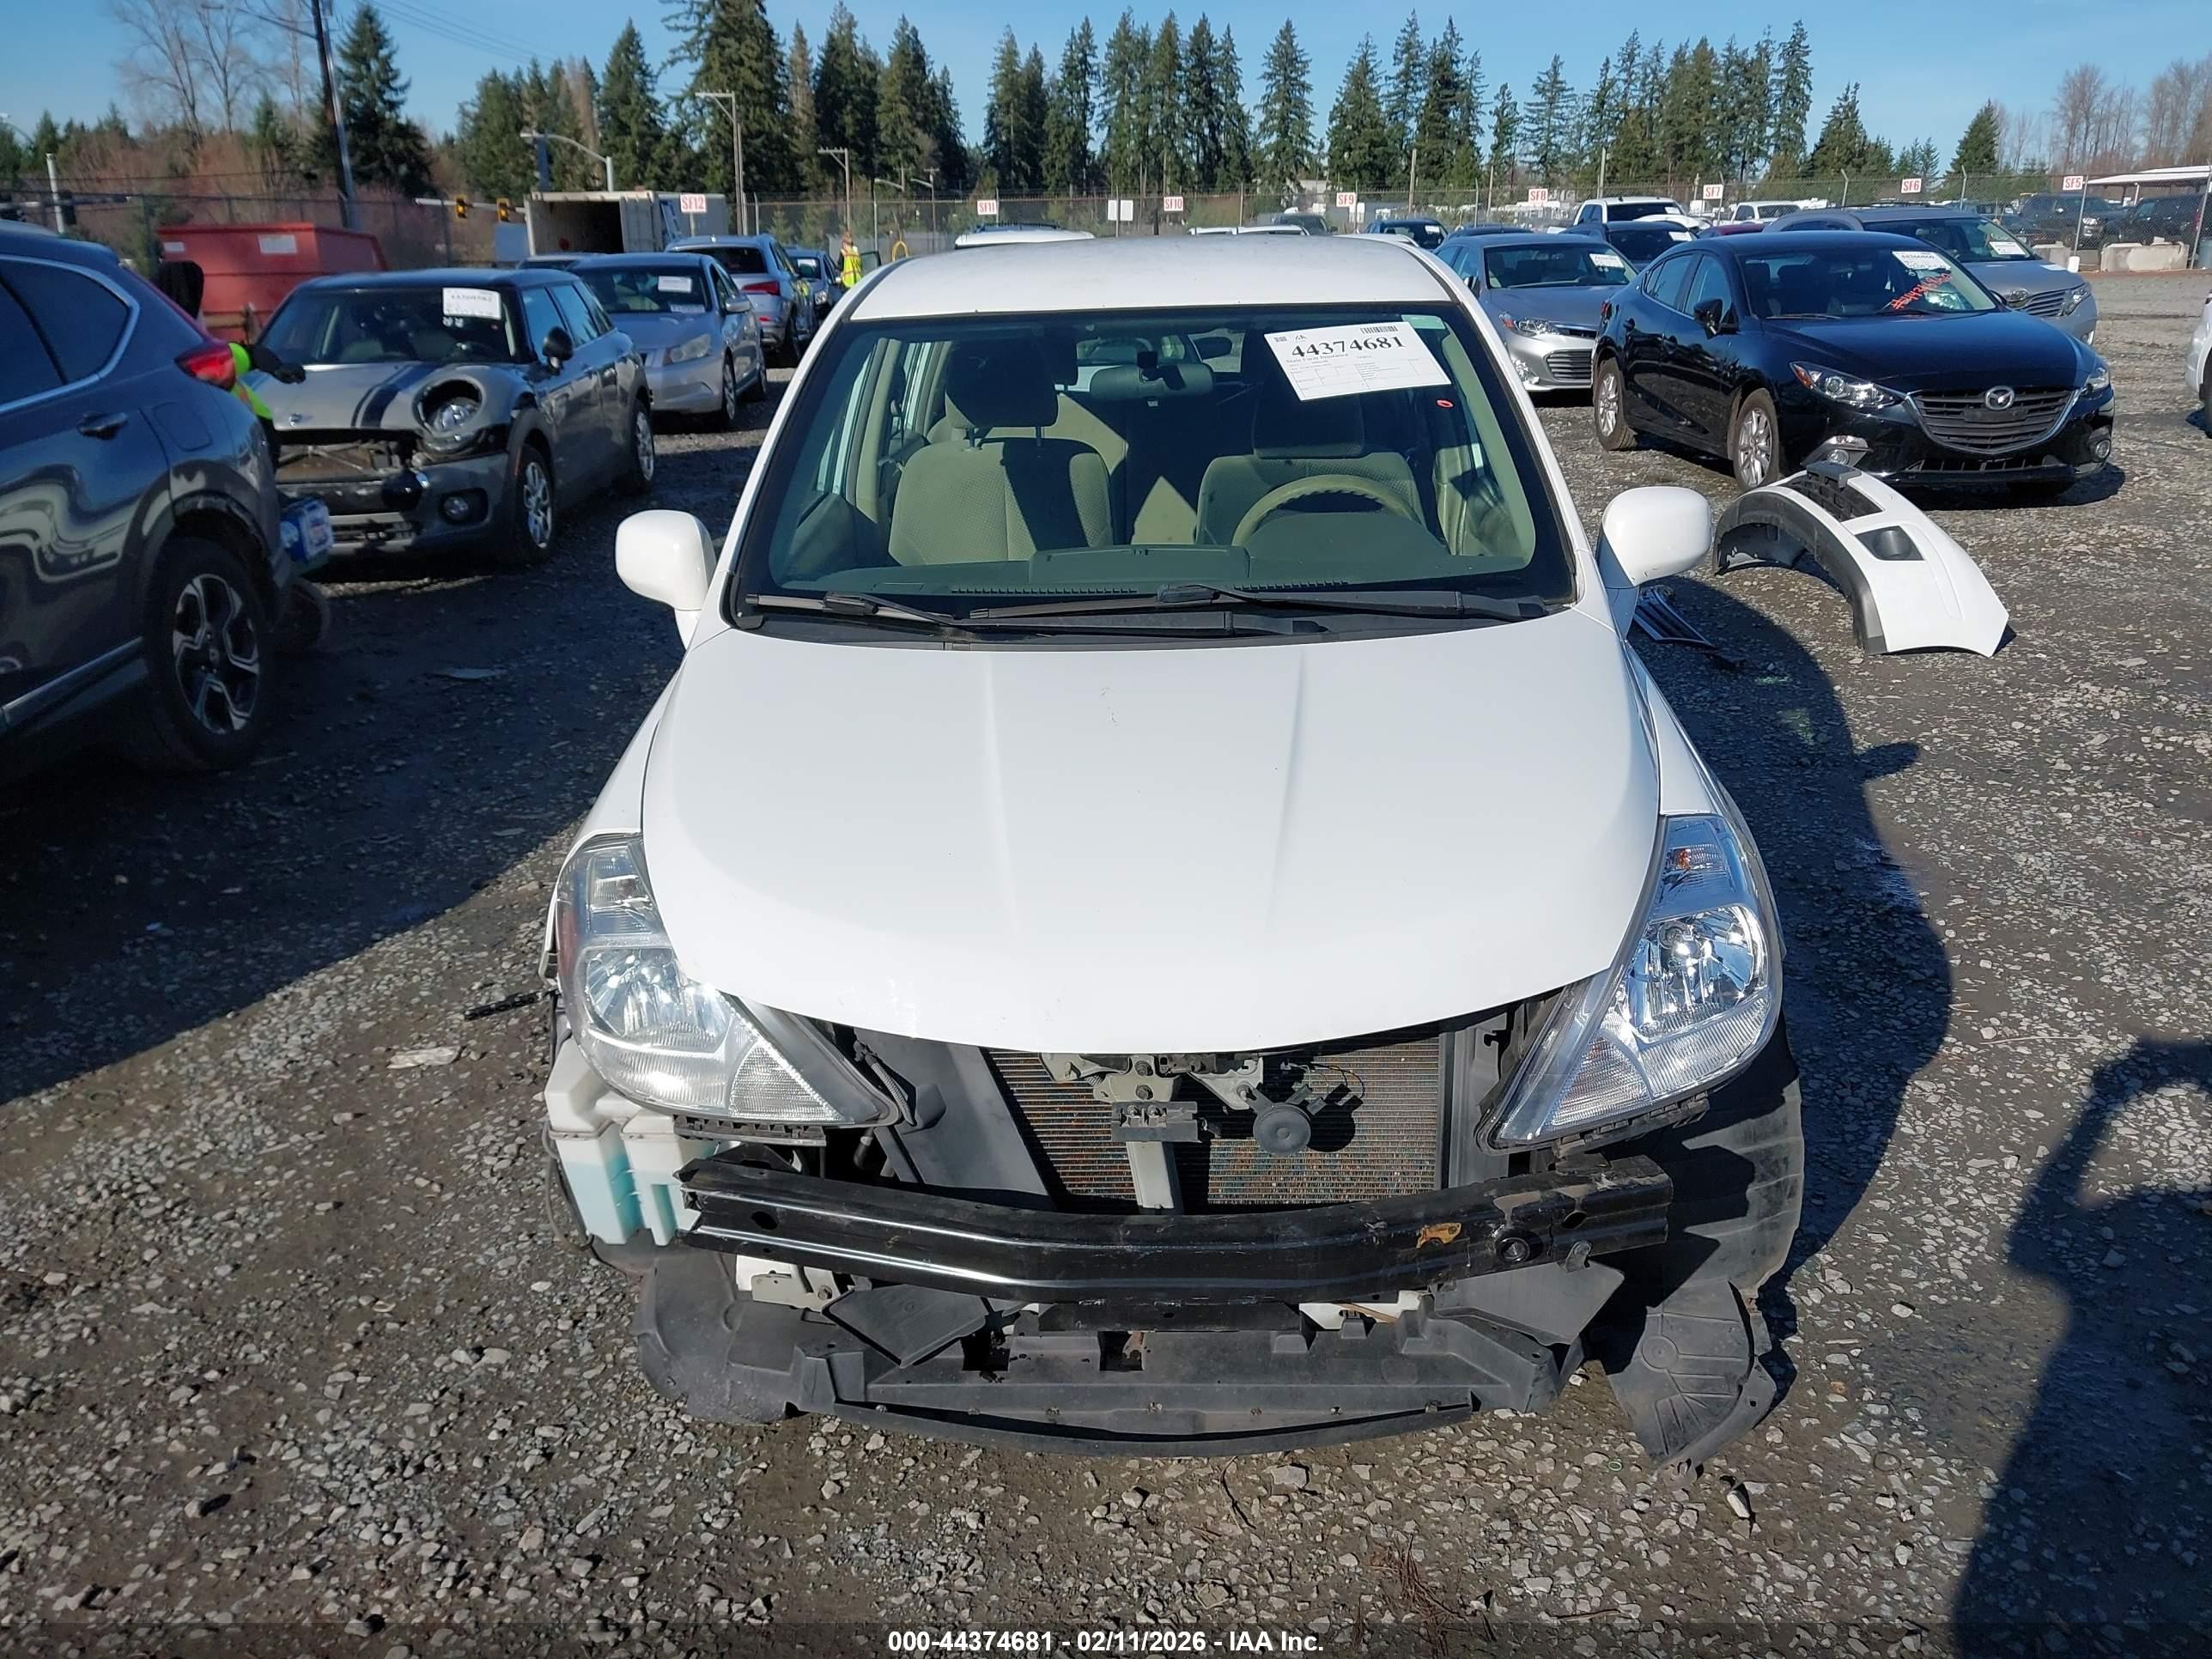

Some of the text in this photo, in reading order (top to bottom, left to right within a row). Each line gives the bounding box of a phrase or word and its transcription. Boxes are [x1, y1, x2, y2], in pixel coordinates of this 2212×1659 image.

[1903, 179, 1920, 191] SF6
[2064, 177, 2081, 189] SF5
[1530, 190, 1547, 202] SF8
[1705, 185, 1721, 198] SF7
[682, 195, 705, 210] SF12
[1338, 193, 1355, 205] SF9
[978, 200, 995, 213] SF11
[1291, 336, 1407, 357] 44374681
